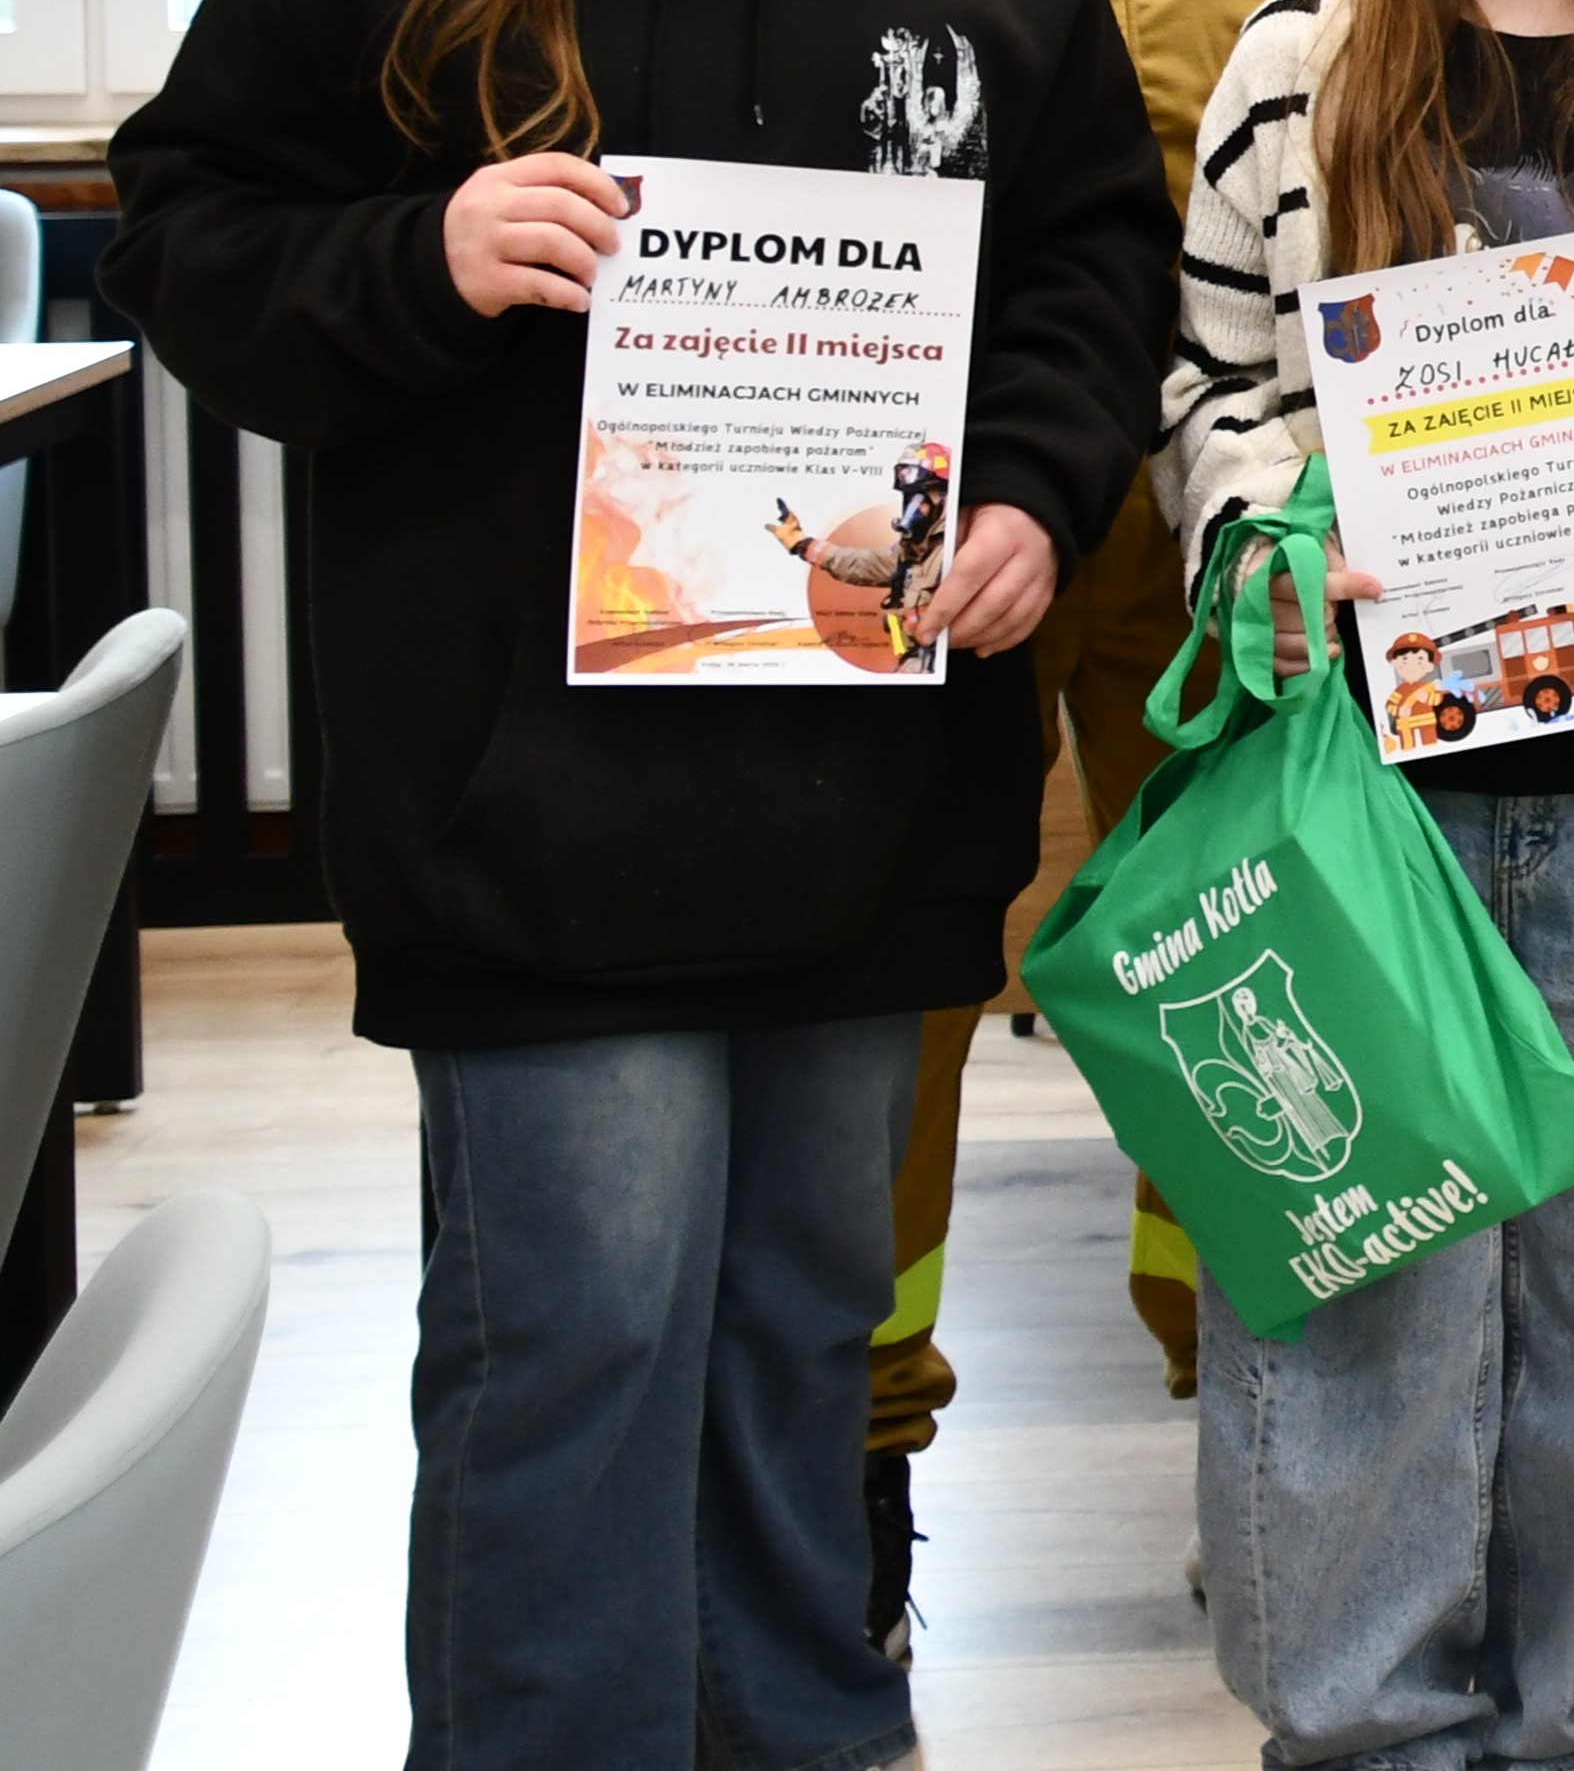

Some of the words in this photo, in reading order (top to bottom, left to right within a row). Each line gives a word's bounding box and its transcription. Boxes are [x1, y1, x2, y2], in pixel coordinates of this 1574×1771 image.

[639, 228, 826, 266] DYPLOM
[838, 238, 922, 272] DLA
[618, 275, 738, 303] MARTYNY
[1415, 313, 1505, 344] Dyplom
[1513, 303, 1552, 324] dla
[614, 326, 654, 350] Za
[663, 327, 778, 360] zajęcie
[786, 332, 808, 356] II
[816, 333, 943, 365] miejsca
[617, 382, 639, 397] W
[645, 383, 801, 401] ELIMINACJACH
[807, 387, 920, 406] GMINNYCH
[1395, 360, 1461, 391] ZOSI
[1388, 420, 1417, 438] ZA
[1423, 401, 1505, 431] ZAJĘCIE
[1510, 398, 1522, 414] II
[1380, 463, 1395, 477] W
[1407, 466, 1540, 501] Ogólnopolskiego
[1436, 498, 1492, 516] Wiedzy
[1480, 507, 1560, 531] zapobiega
[1398, 557, 1410, 567] w
[1416, 541, 1489, 564] kategorii
[1495, 525, 1571, 550] uczniowie
[1112, 912, 1203, 996] Gmina
[1199, 855, 1279, 940] Kotla
[1285, 1183, 1377, 1248] Jestem
[1288, 1159, 1489, 1300] EKO-active!
